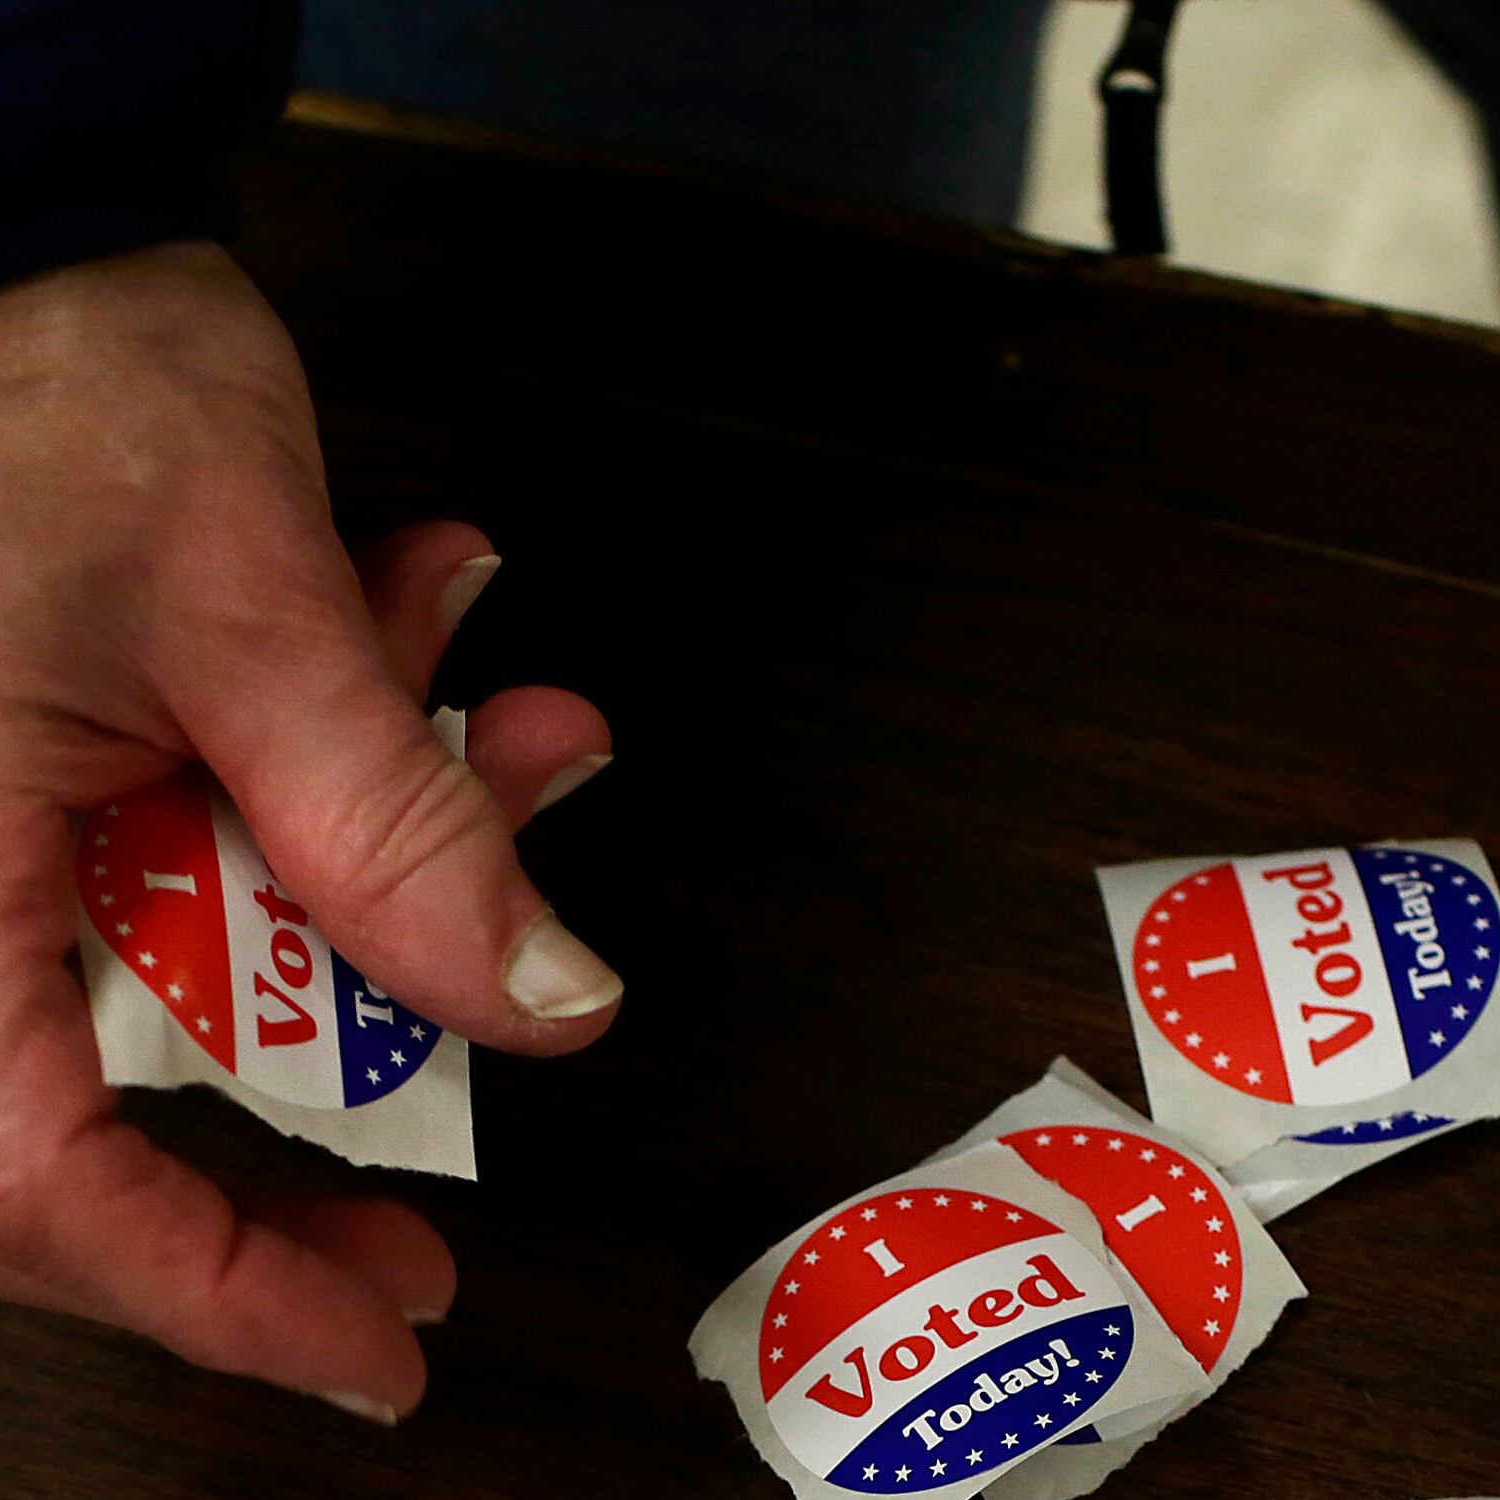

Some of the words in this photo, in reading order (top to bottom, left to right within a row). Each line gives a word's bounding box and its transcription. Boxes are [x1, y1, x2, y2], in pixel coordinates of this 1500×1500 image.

[143, 870, 197, 895] I
[1380, 870, 1453, 999] Today!
[253, 884, 318, 1047] Vot
[1186, 953, 1236, 980] I
[1263, 861, 1375, 1066] Voted
[863, 1237, 906, 1277] I
[1115, 1194, 1167, 1232] I
[805, 1254, 1086, 1418] Voted
[902, 1340, 1081, 1451] Today!
